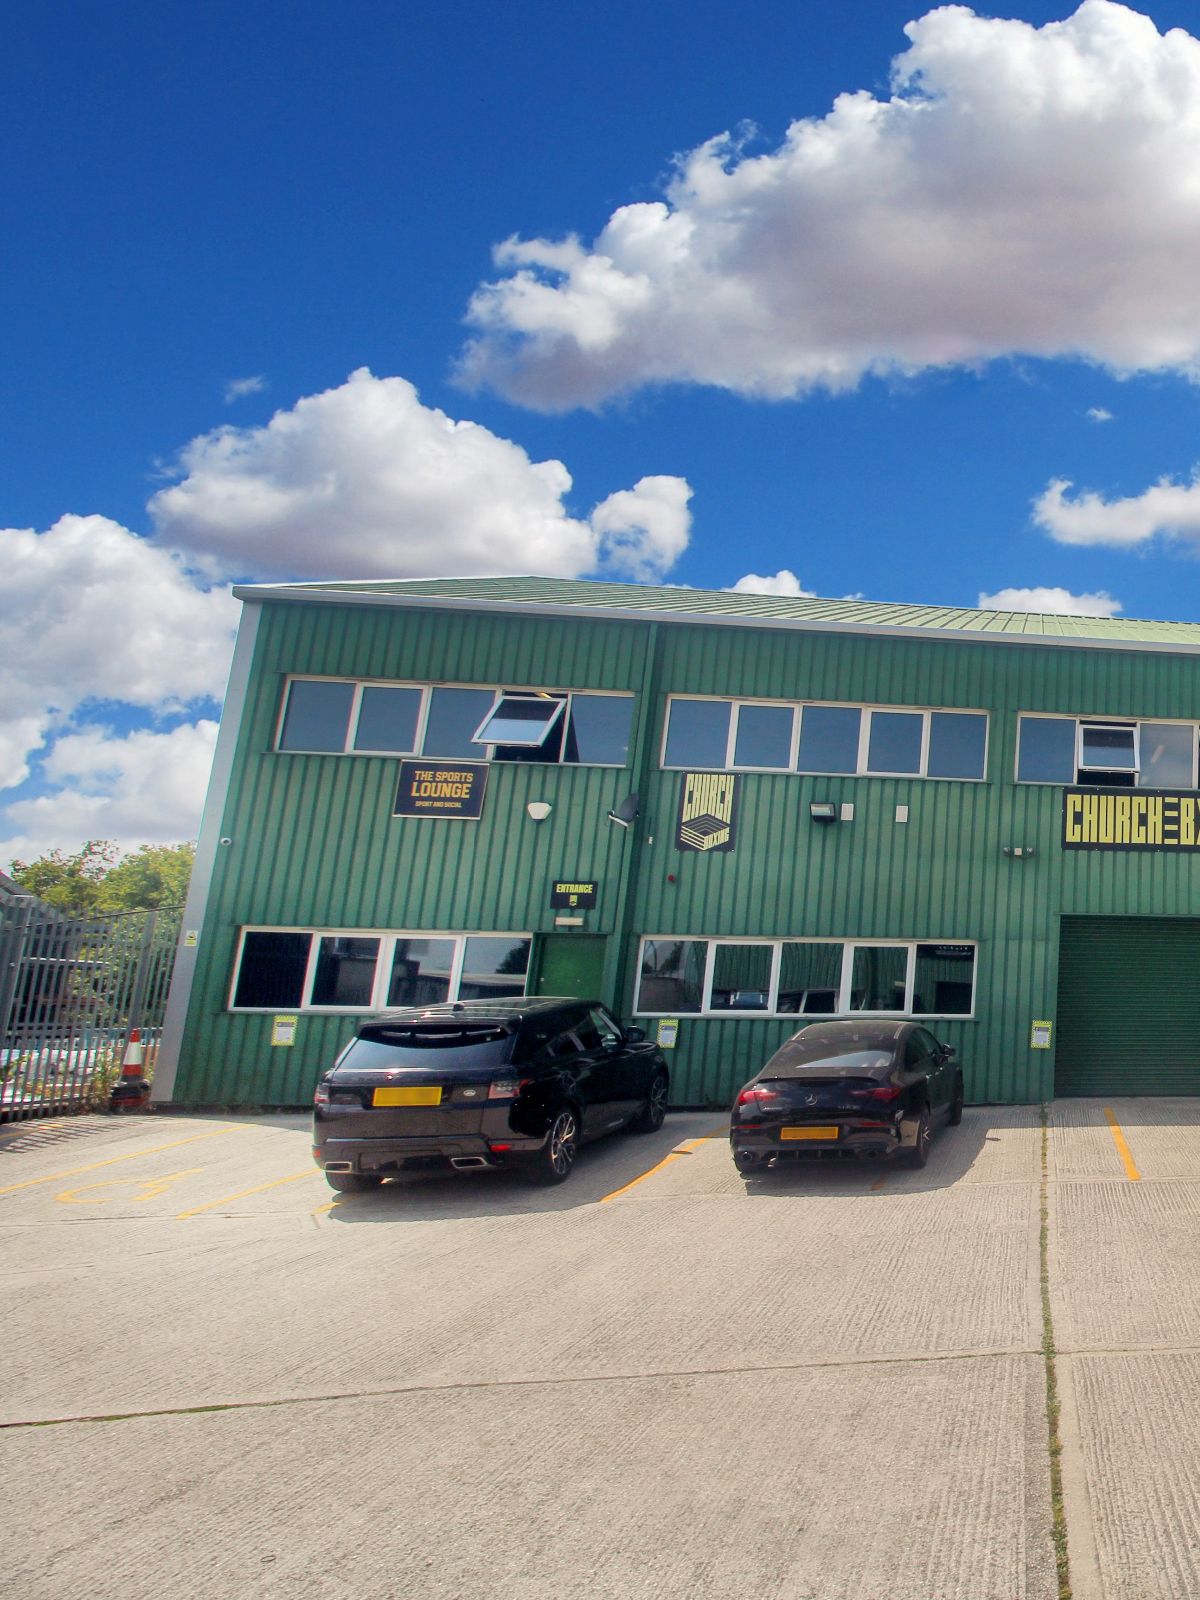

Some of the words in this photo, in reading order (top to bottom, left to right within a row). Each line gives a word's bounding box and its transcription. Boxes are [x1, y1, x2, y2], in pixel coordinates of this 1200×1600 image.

[414, 771, 434, 781] THE
[435, 772, 474, 782] SPORTS
[411, 782, 472, 798] LOUNGE
[682, 773, 735, 824] CHURCH
[1066, 794, 1163, 844] CHURCH
[556, 883, 593, 894] ENTRANCE
